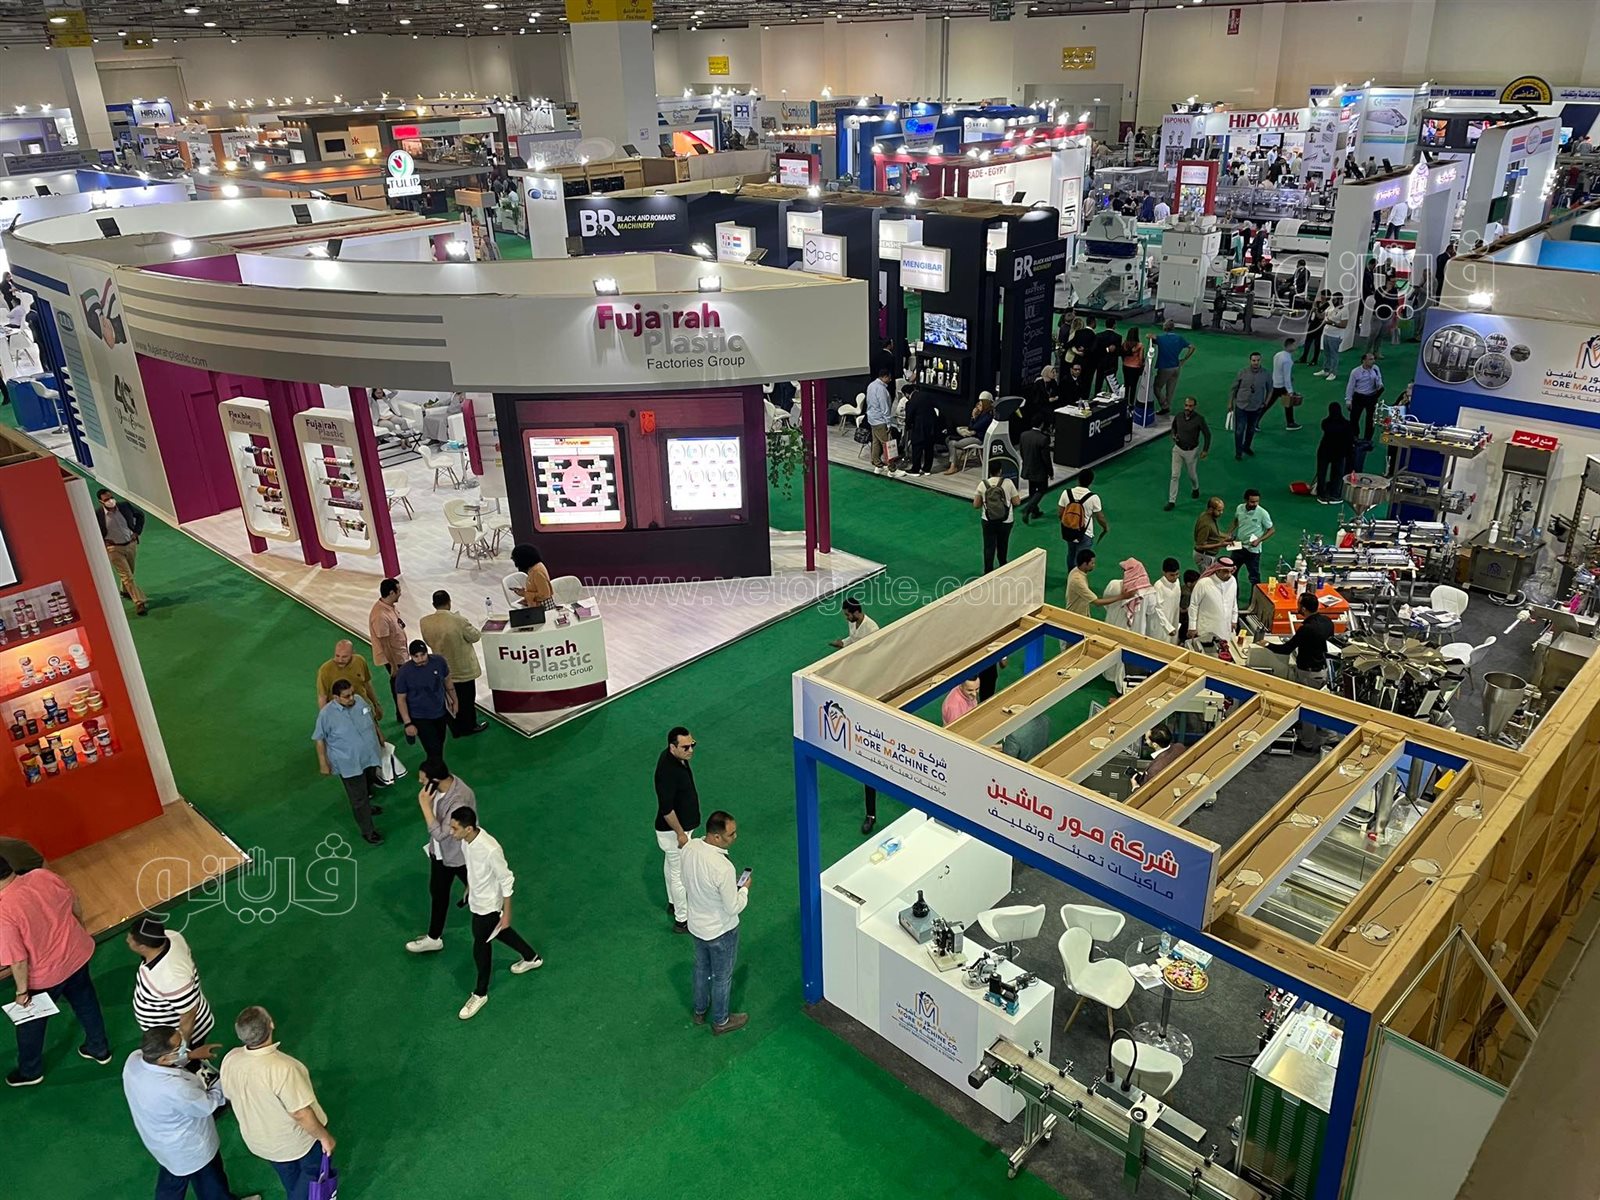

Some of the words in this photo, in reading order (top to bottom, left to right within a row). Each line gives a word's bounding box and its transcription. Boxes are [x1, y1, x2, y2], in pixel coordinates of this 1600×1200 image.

[988, 165, 1007, 177] EGYPT
[389, 177, 419, 188] TULIP
[617, 222, 655, 230] MACHINERY
[637, 214, 650, 222] AND
[650, 213, 676, 221] ROMANS
[902, 259, 943, 272] MENGIBAR
[597, 302, 721, 338] Fujairah
[644, 320, 745, 355] Plastic
[647, 356, 704, 370] Factories
[707, 355, 746, 368] Group
[1543, 378, 1571, 389] MORE
[228, 410, 251, 420] Flexible
[305, 419, 337, 430] Fujairah
[319, 427, 344, 439] Plastic
[498, 640, 577, 664] Fujairah
[528, 652, 592, 674] Plastic
[530, 671, 568, 682] Factories
[569, 665, 594, 677] Group
[855, 721, 896, 746] ماشين
[897, 742, 917, 753] مور
[854, 734, 881, 753] MORE
[884, 746, 929, 775] MACHINE
[931, 767, 948, 783] CO.
[918, 748, 947, 769] شركة
[986, 778, 1054, 821] ماشين
[988, 806, 1045, 842] وتغليف
[1057, 815, 1105, 845] مور
[1047, 832, 1105, 867] تعبئة
[1110, 831, 1180, 878] شركة
[1107, 861, 1174, 900] ماكينات
[916, 1020, 946, 1045] MACHINE
